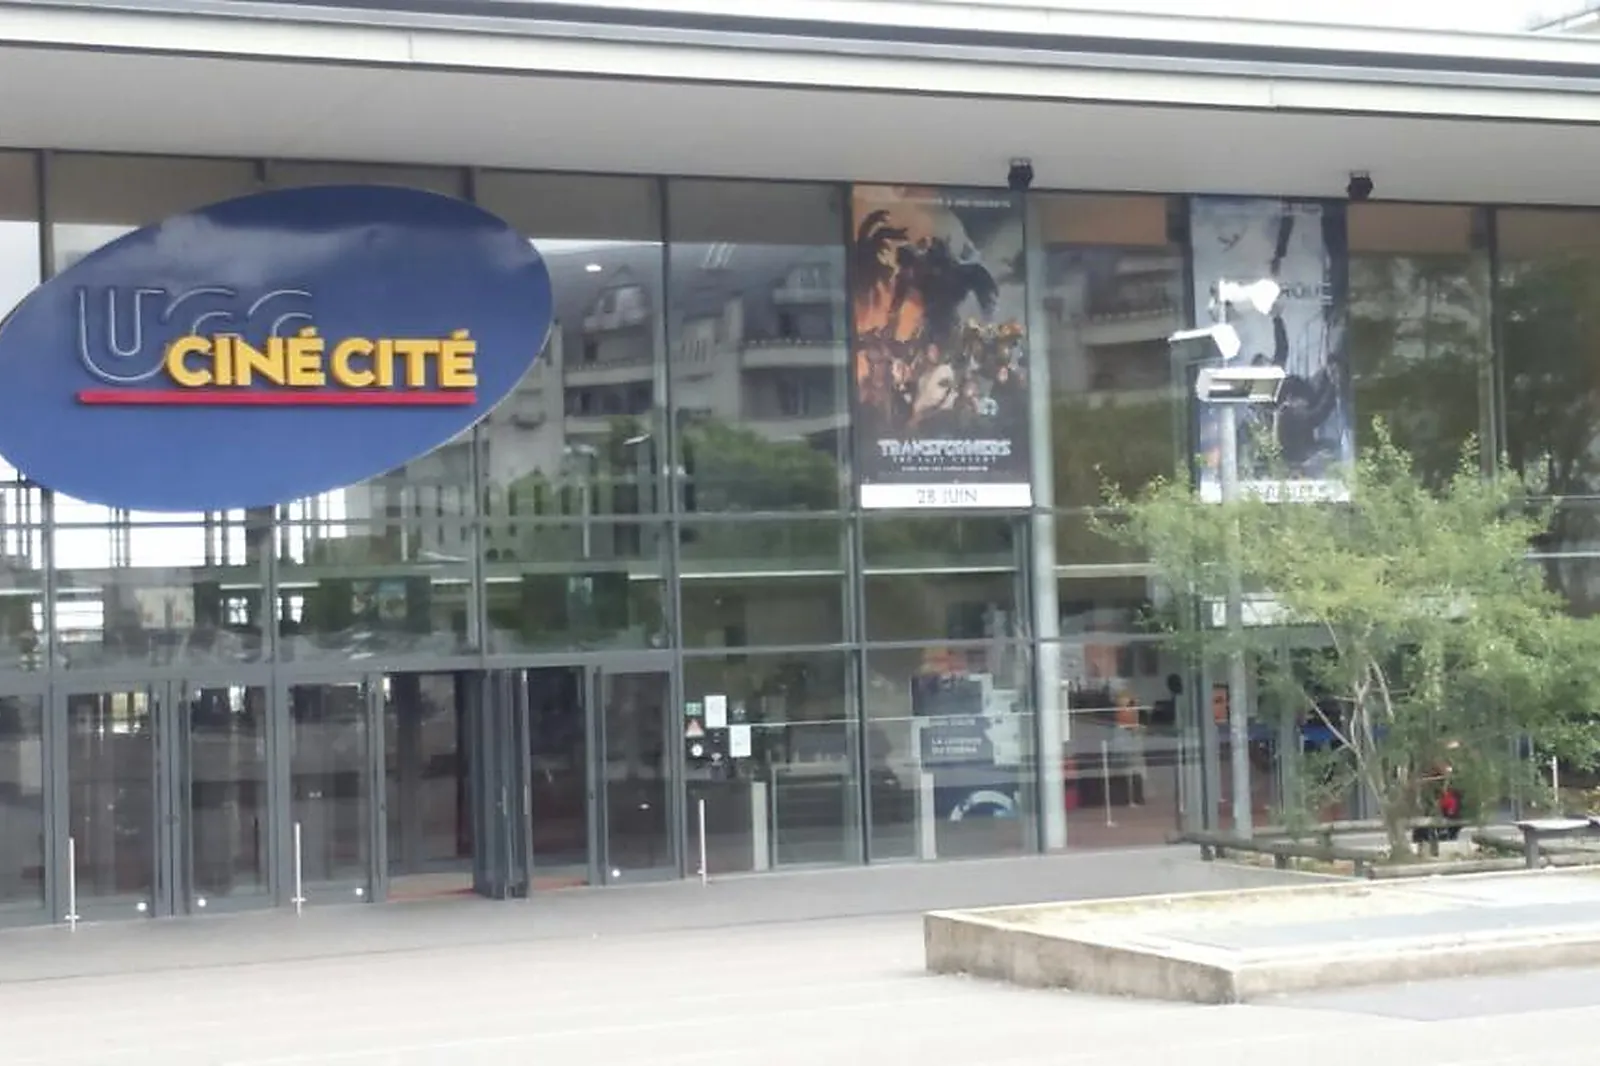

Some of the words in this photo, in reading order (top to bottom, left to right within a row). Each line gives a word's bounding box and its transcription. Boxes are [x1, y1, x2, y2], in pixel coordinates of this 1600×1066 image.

[166, 328, 325, 387] CINÉ
[333, 329, 478, 387] CITÉ
[878, 439, 1012, 456] TRANSFORMERS
